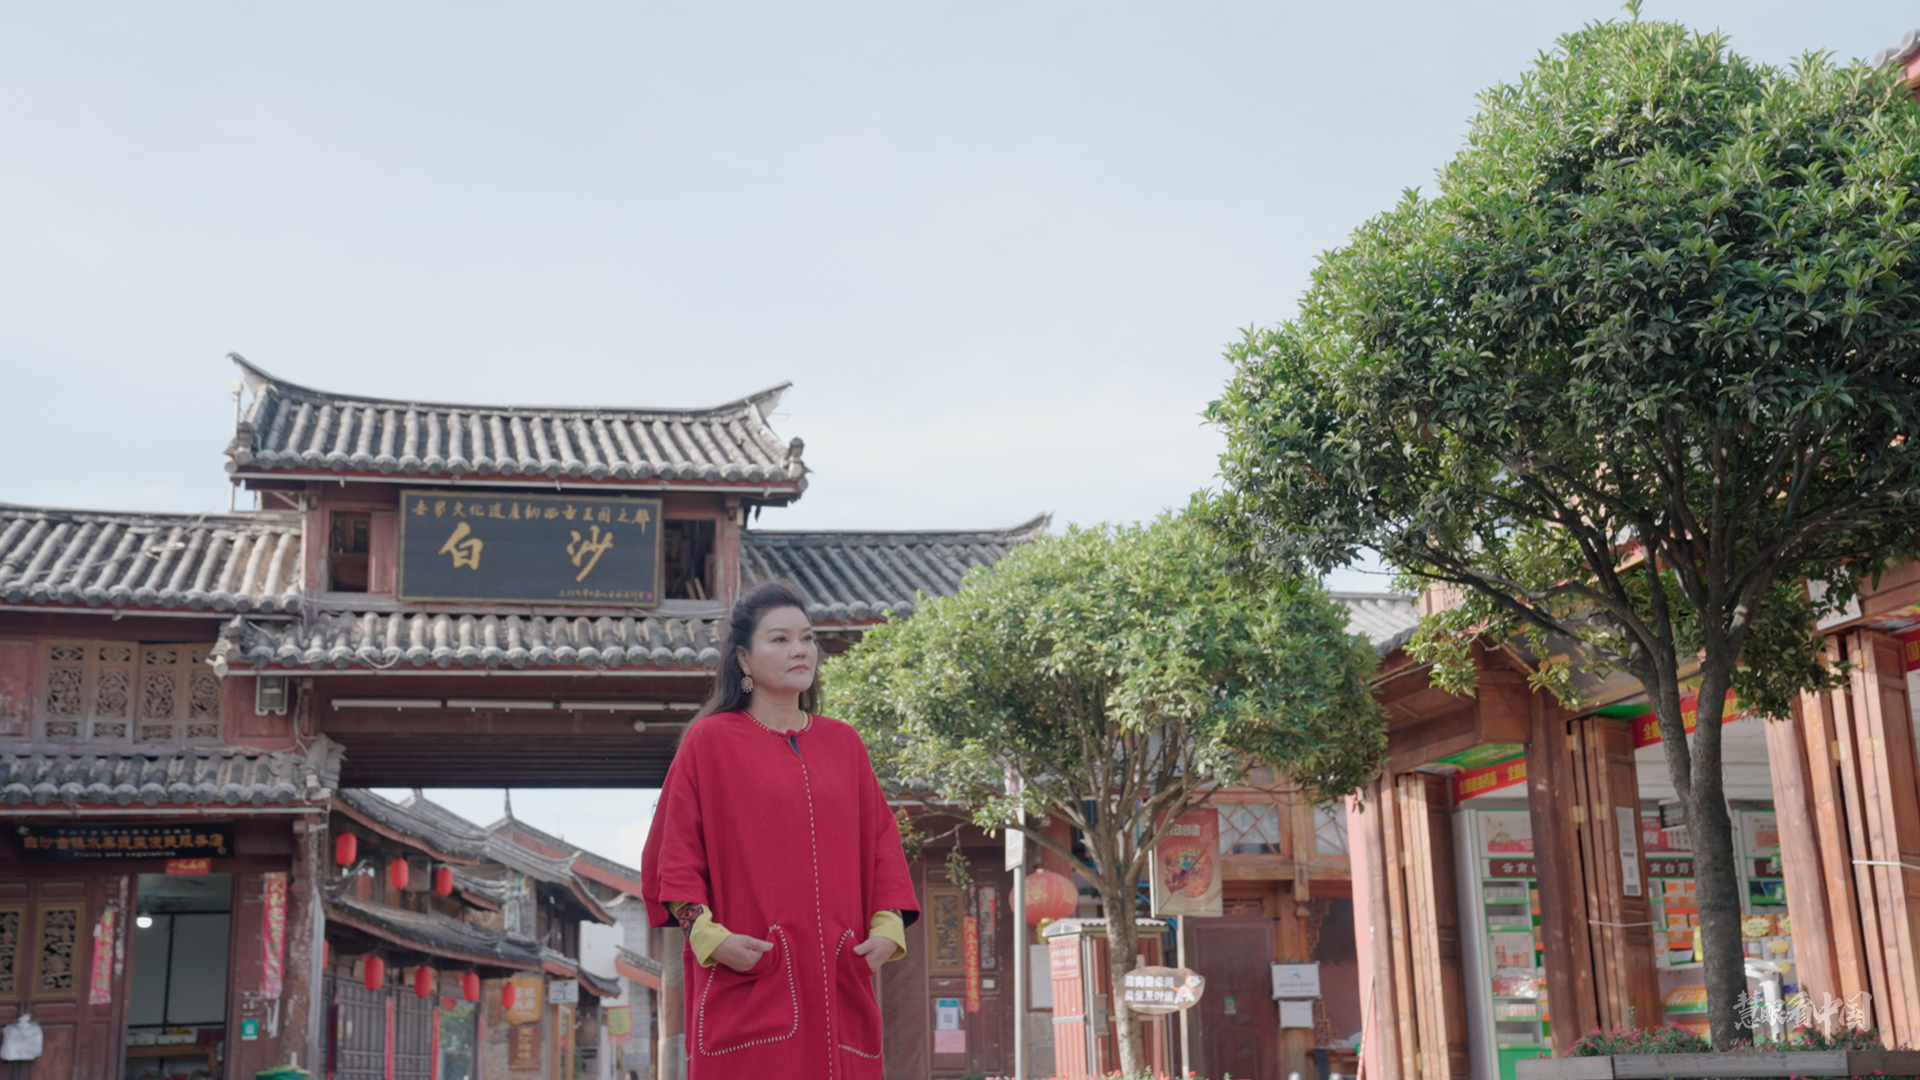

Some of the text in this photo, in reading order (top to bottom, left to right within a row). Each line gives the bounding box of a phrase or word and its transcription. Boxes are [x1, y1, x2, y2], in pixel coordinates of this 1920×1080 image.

[438, 521, 614, 582] 白沙
[1650, 861, 1694, 875] 南白药
